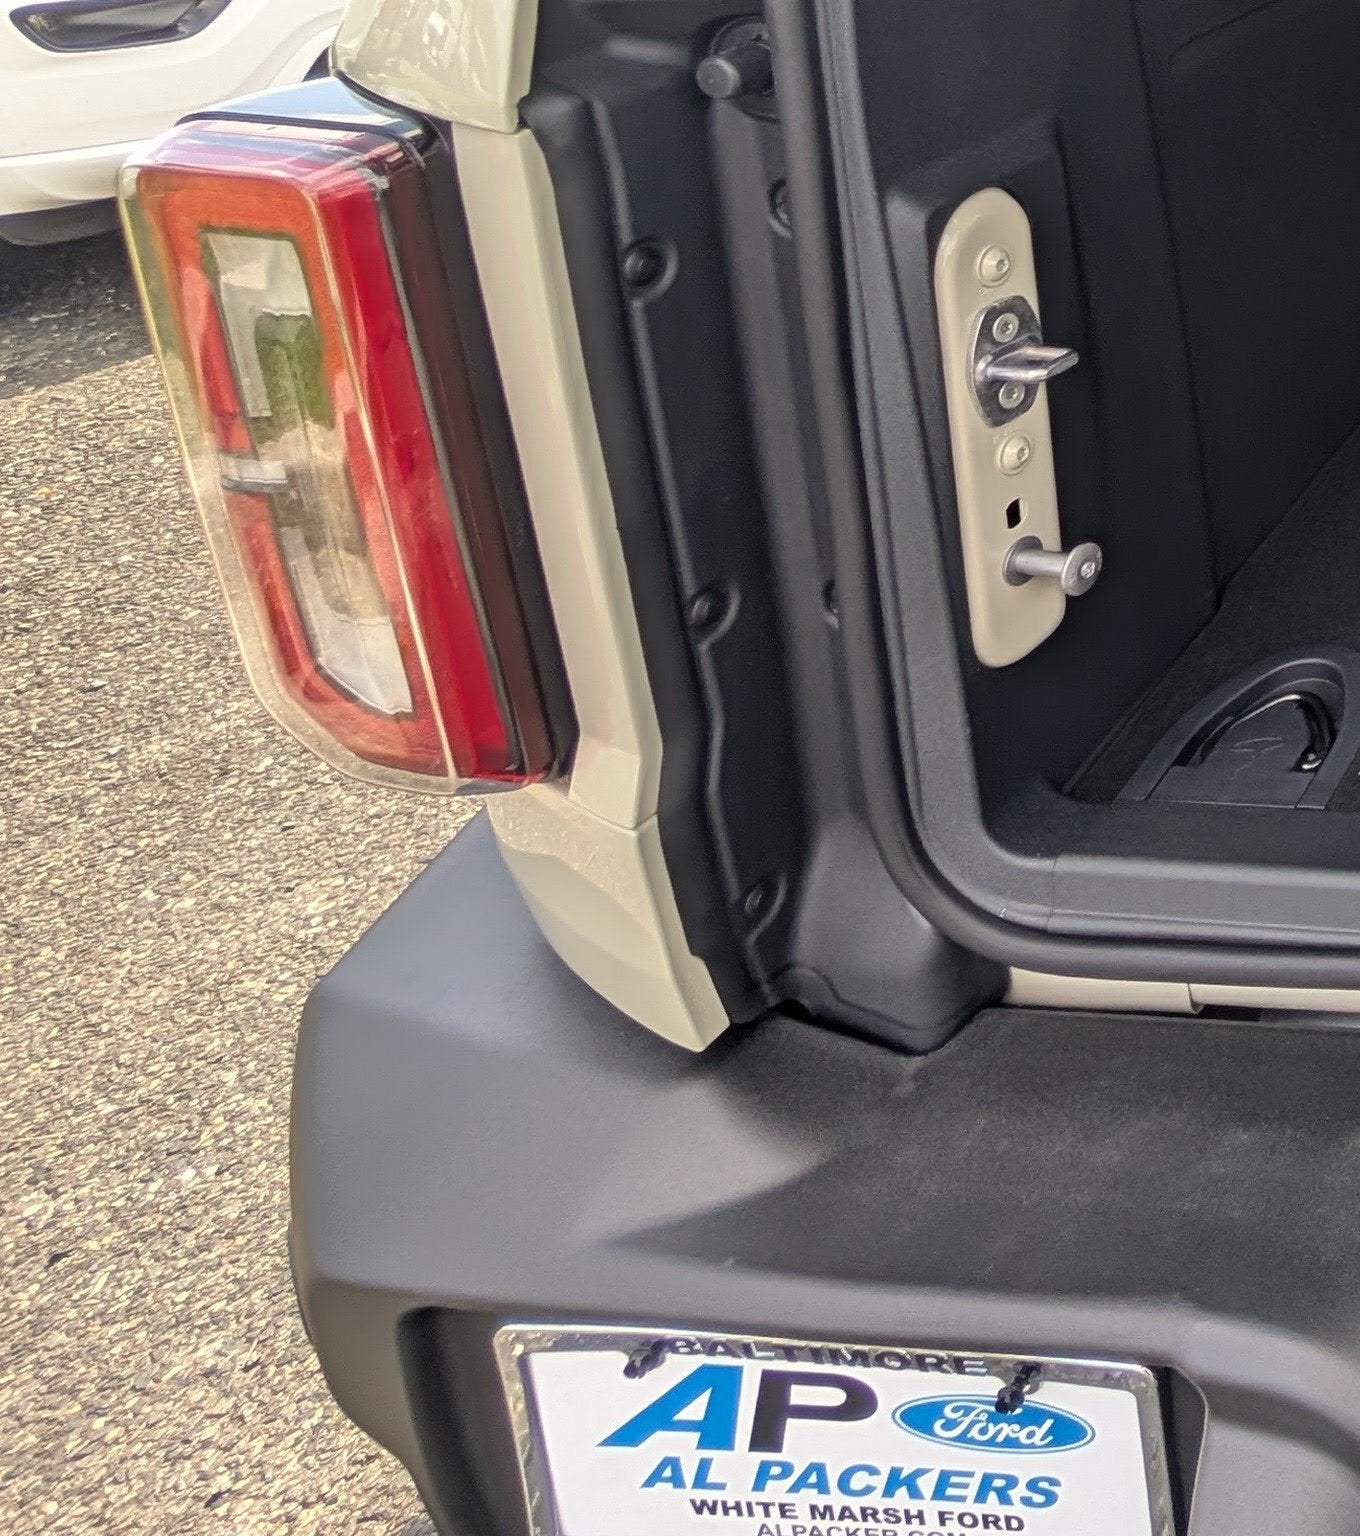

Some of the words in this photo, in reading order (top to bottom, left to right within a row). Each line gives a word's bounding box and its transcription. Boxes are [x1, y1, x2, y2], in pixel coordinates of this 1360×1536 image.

[671, 1337, 988, 1376] BALTIMORE
[595, 1363, 879, 1454] AP
[930, 1398, 1057, 1450] Ford
[639, 1456, 729, 1493] AL
[750, 1459, 1062, 1510] PACKERS
[689, 1498, 798, 1521] WHITE
[808, 1503, 928, 1527] MARSH
[937, 1509, 1026, 1533] FORD
